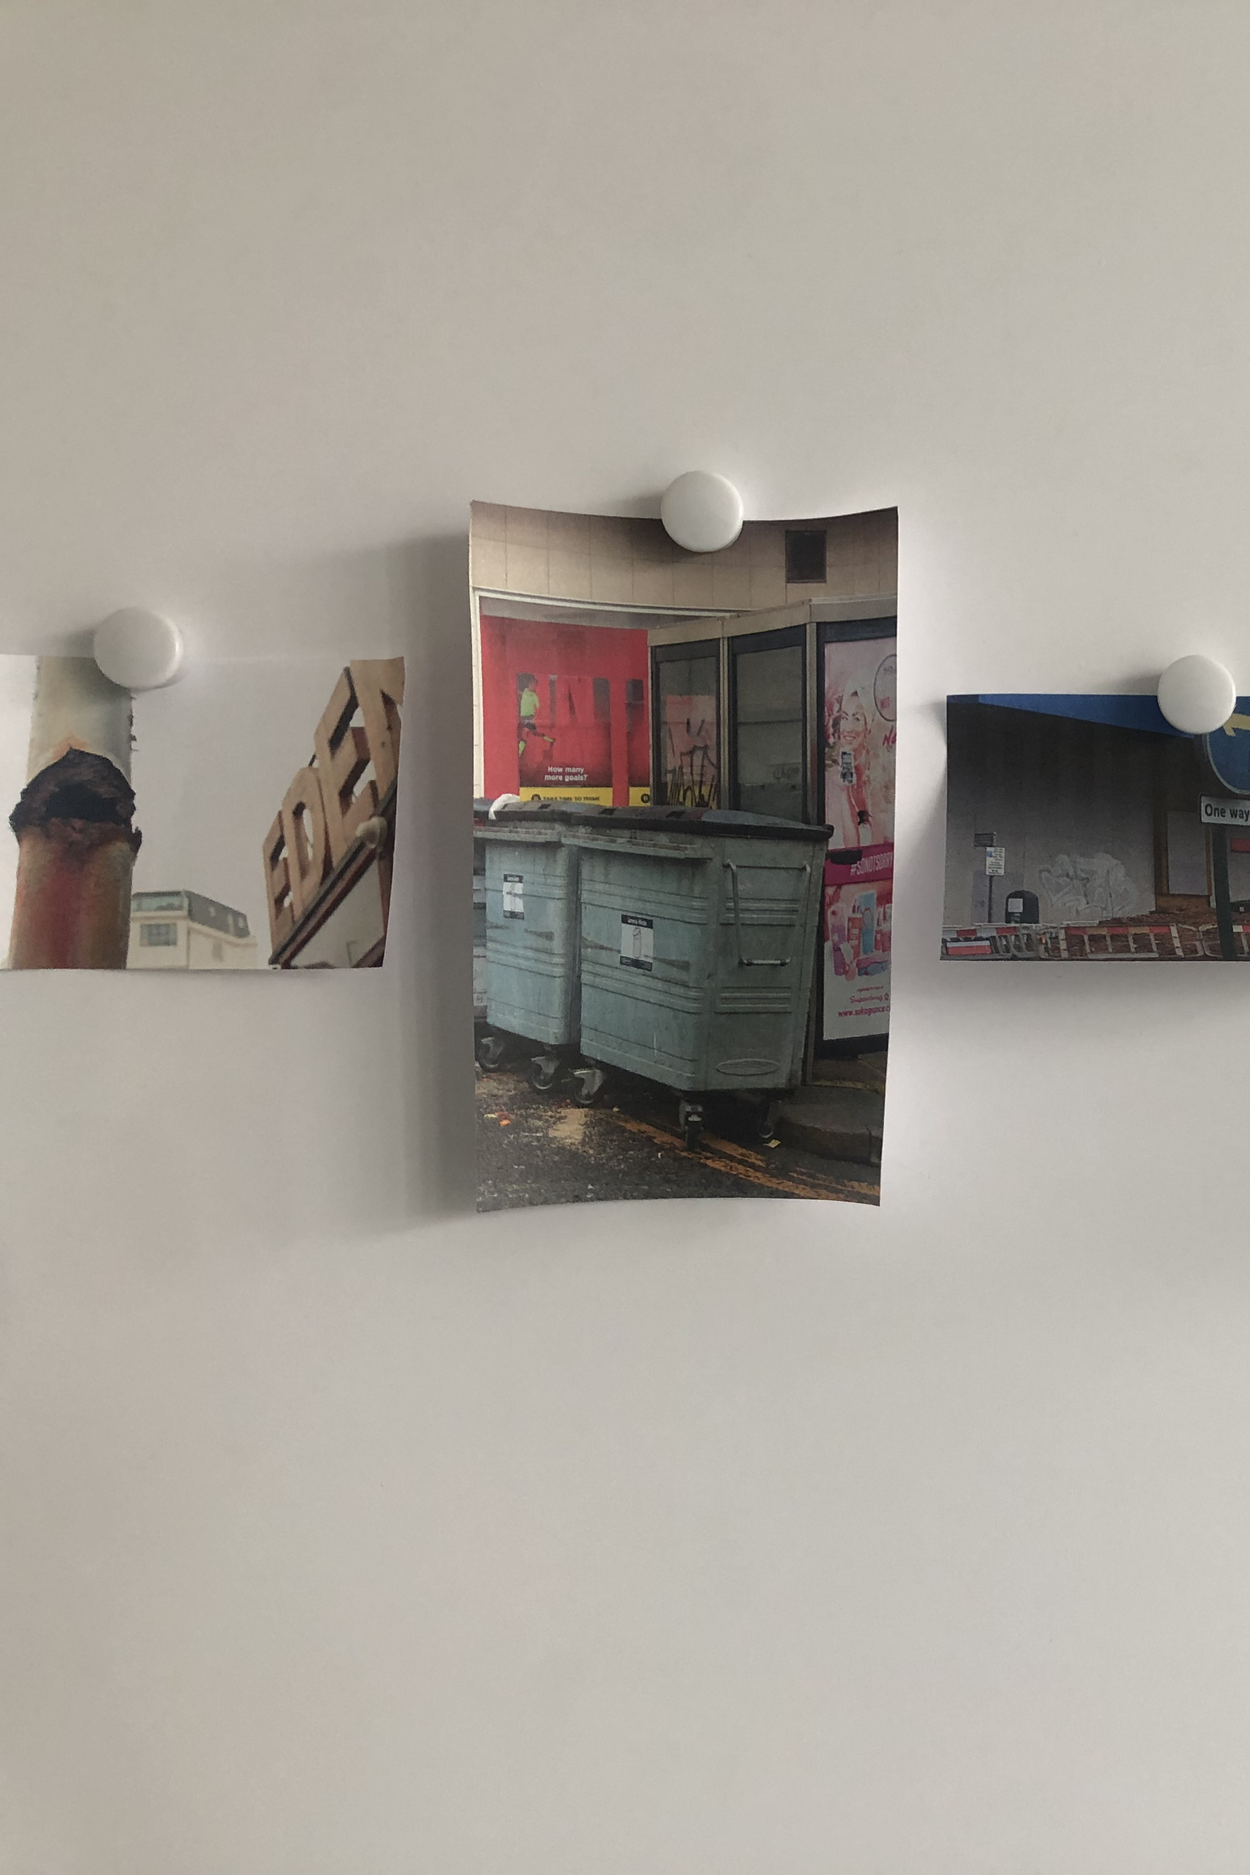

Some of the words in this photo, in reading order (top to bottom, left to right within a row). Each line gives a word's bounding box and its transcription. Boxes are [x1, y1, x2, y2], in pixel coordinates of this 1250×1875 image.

[547, 765, 563, 773] How
[565, 766, 584, 774] many
[1204, 803, 1226, 818] One
[1230, 808, 1250, 822] way
